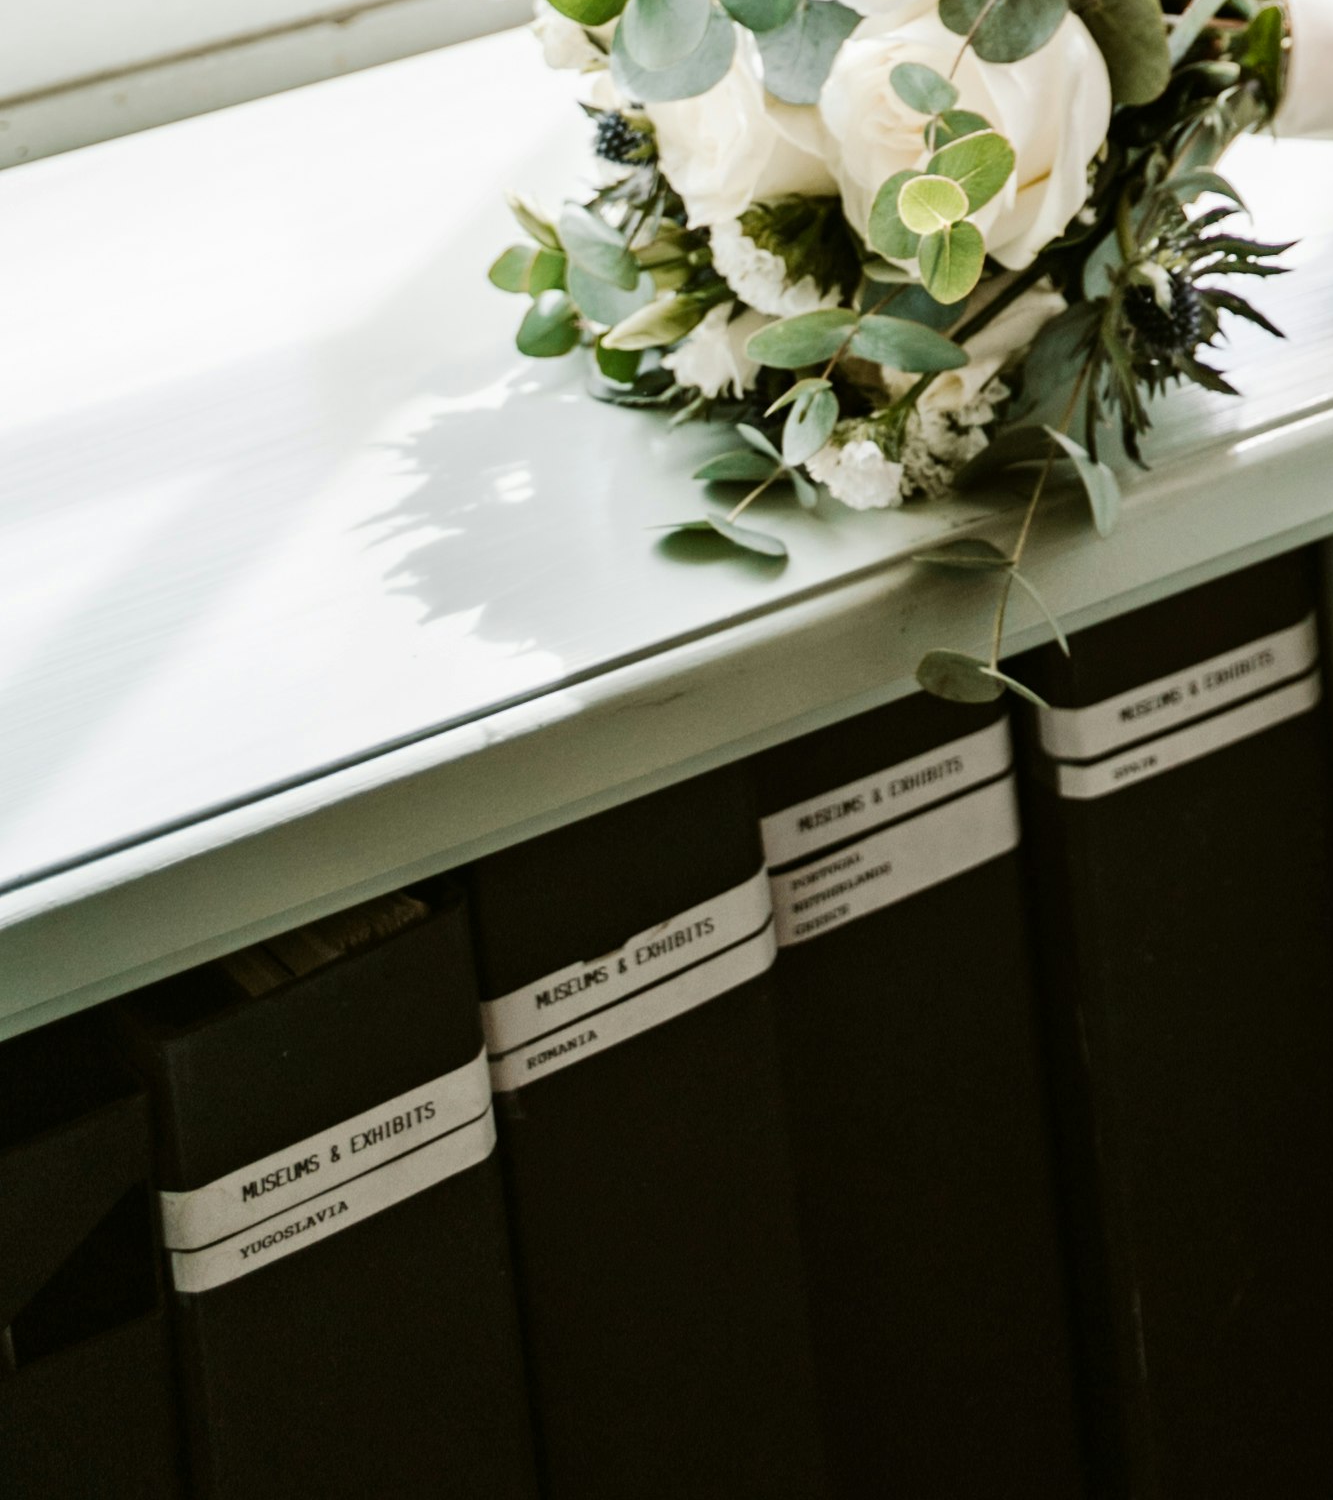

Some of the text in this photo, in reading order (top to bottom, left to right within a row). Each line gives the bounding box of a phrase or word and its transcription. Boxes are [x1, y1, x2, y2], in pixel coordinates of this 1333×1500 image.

[796, 755, 964, 833] MUSEUMS & EXHIBITS
[791, 852, 864, 891] PORTUGAL
[534, 916, 715, 1010] MUSEUMS & EXHIBITS
[526, 1029, 599, 1070] ROMANIA
[241, 1100, 437, 1203] MUSEUMS & EXHIBITS
[238, 1199, 350, 1260] YUGOSLAVIA
